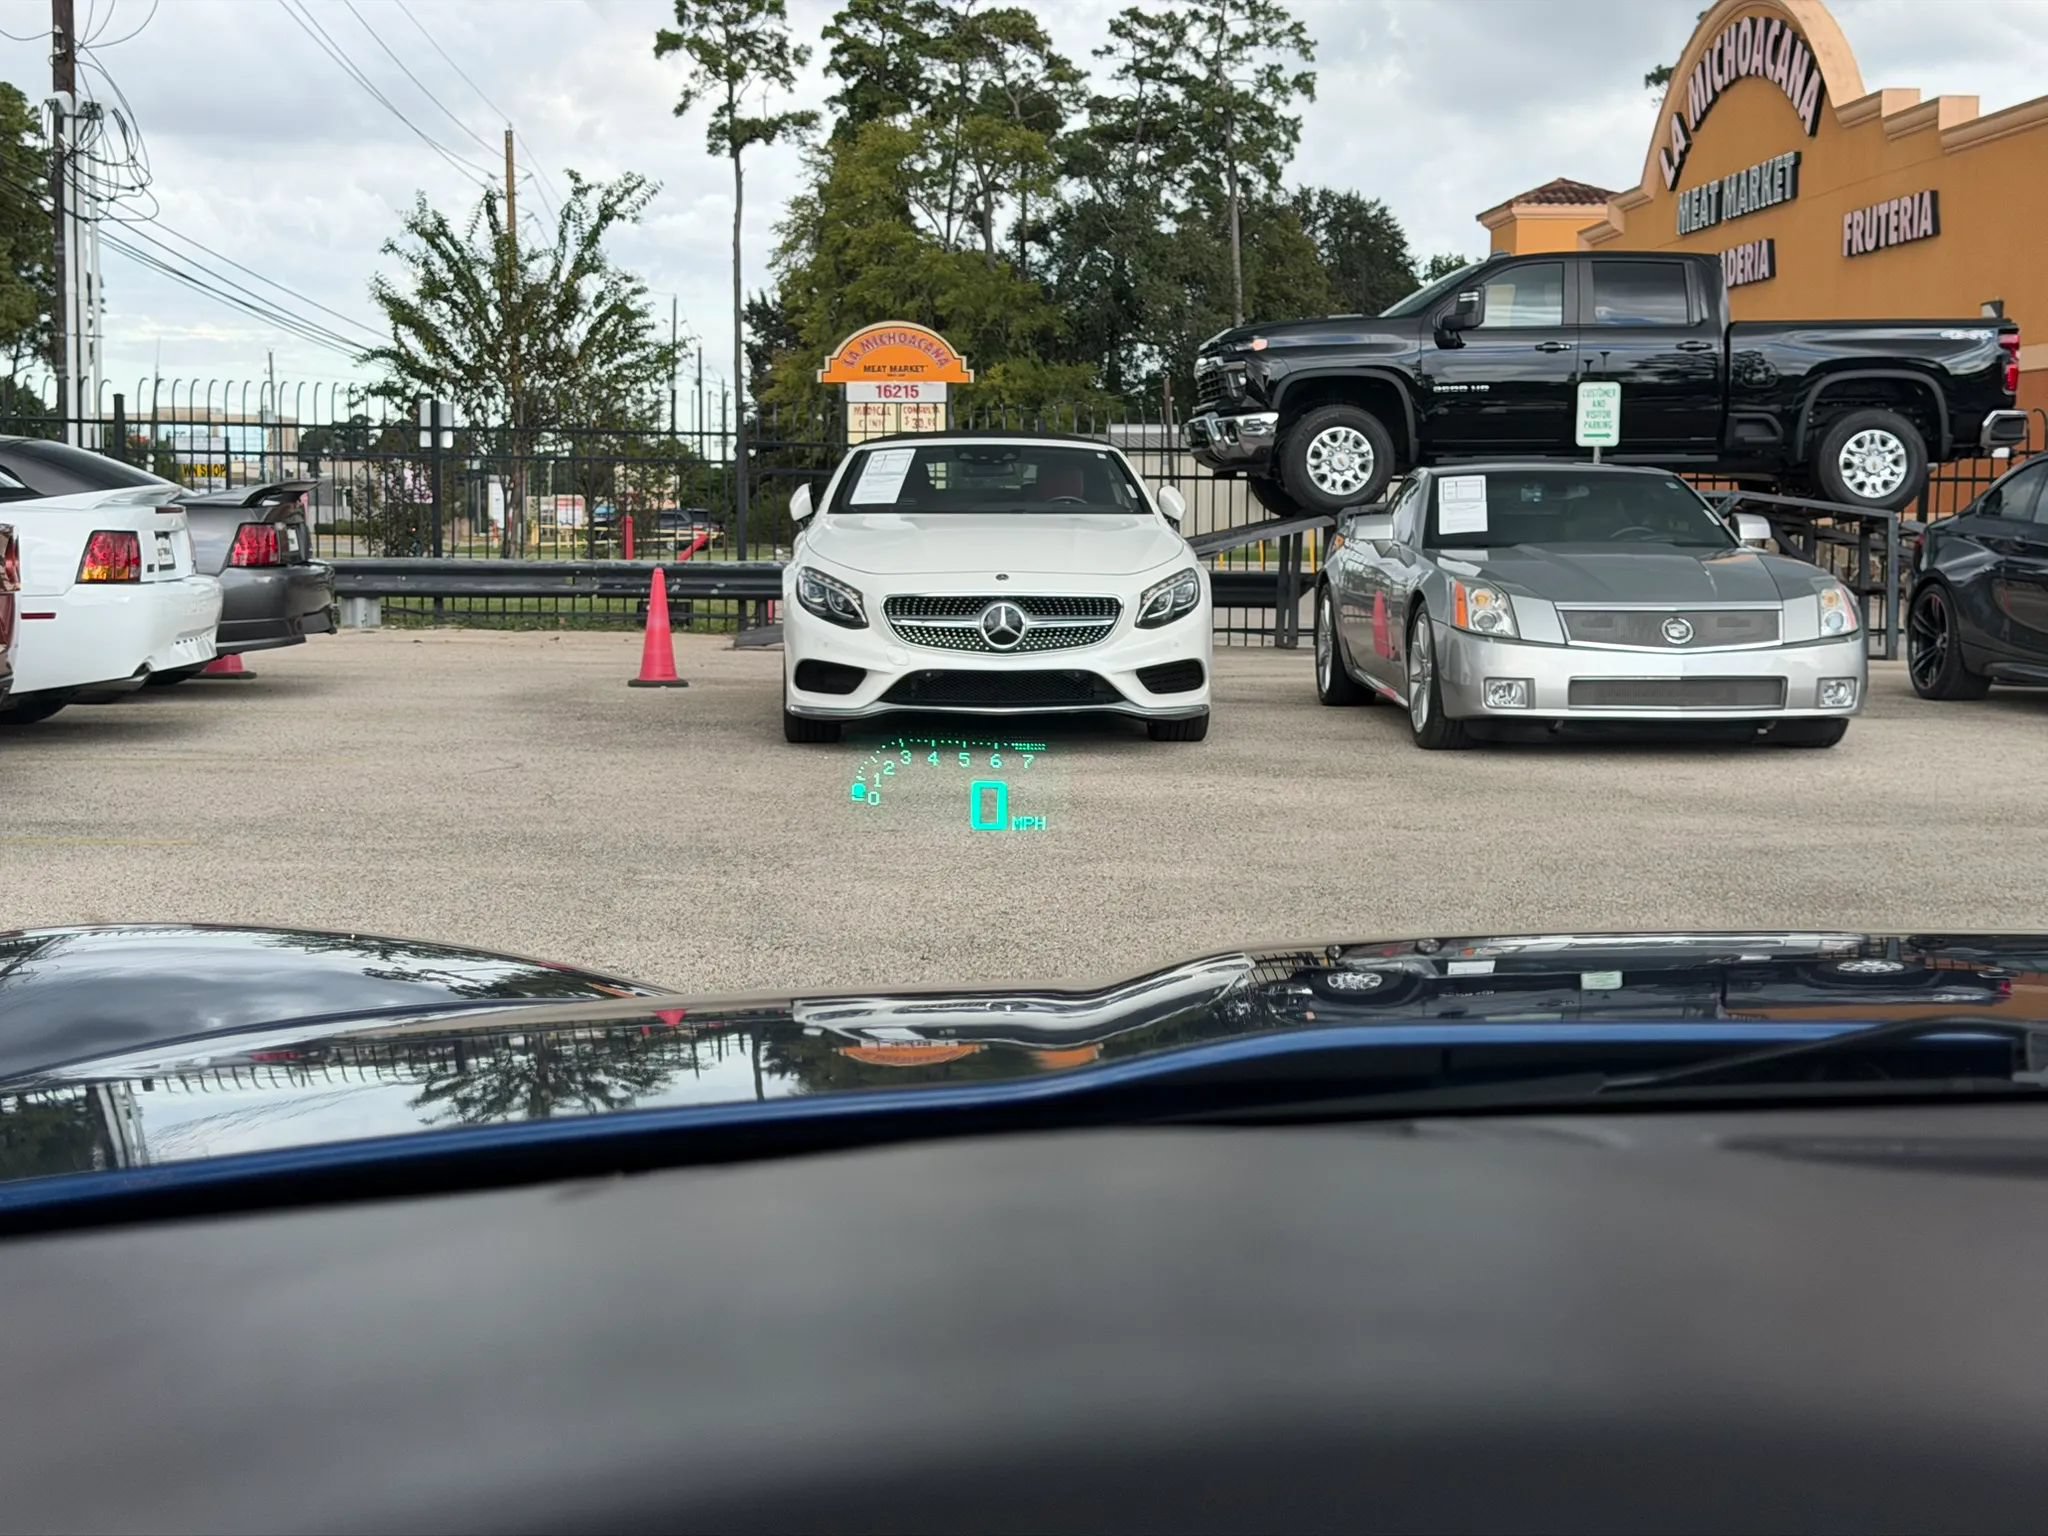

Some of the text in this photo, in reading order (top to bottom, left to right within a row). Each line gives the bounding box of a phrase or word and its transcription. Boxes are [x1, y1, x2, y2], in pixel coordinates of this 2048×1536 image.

[1659, 16, 1825, 191] LA MICHOACANA
[1677, 151, 1800, 236] MEAT MARKET
[1842, 190, 1937, 257] FRUTERIA
[843, 331, 951, 369] LA MICHOACANA
[864, 365, 925, 373] MEAT MARKET
[875, 384, 920, 399] 16215
[1592, 399, 1606, 408] AND
[183, 463, 198, 478] WN
[883, 760, 896, 776] 2
[900, 749, 912, 765] 3
[927, 750, 940, 767] 4
[958, 752, 971, 768] 5
[989, 753, 1003, 769] 6
[1022, 754, 1035, 769] 7
[970, 779, 1047, 832] 0 MPH
